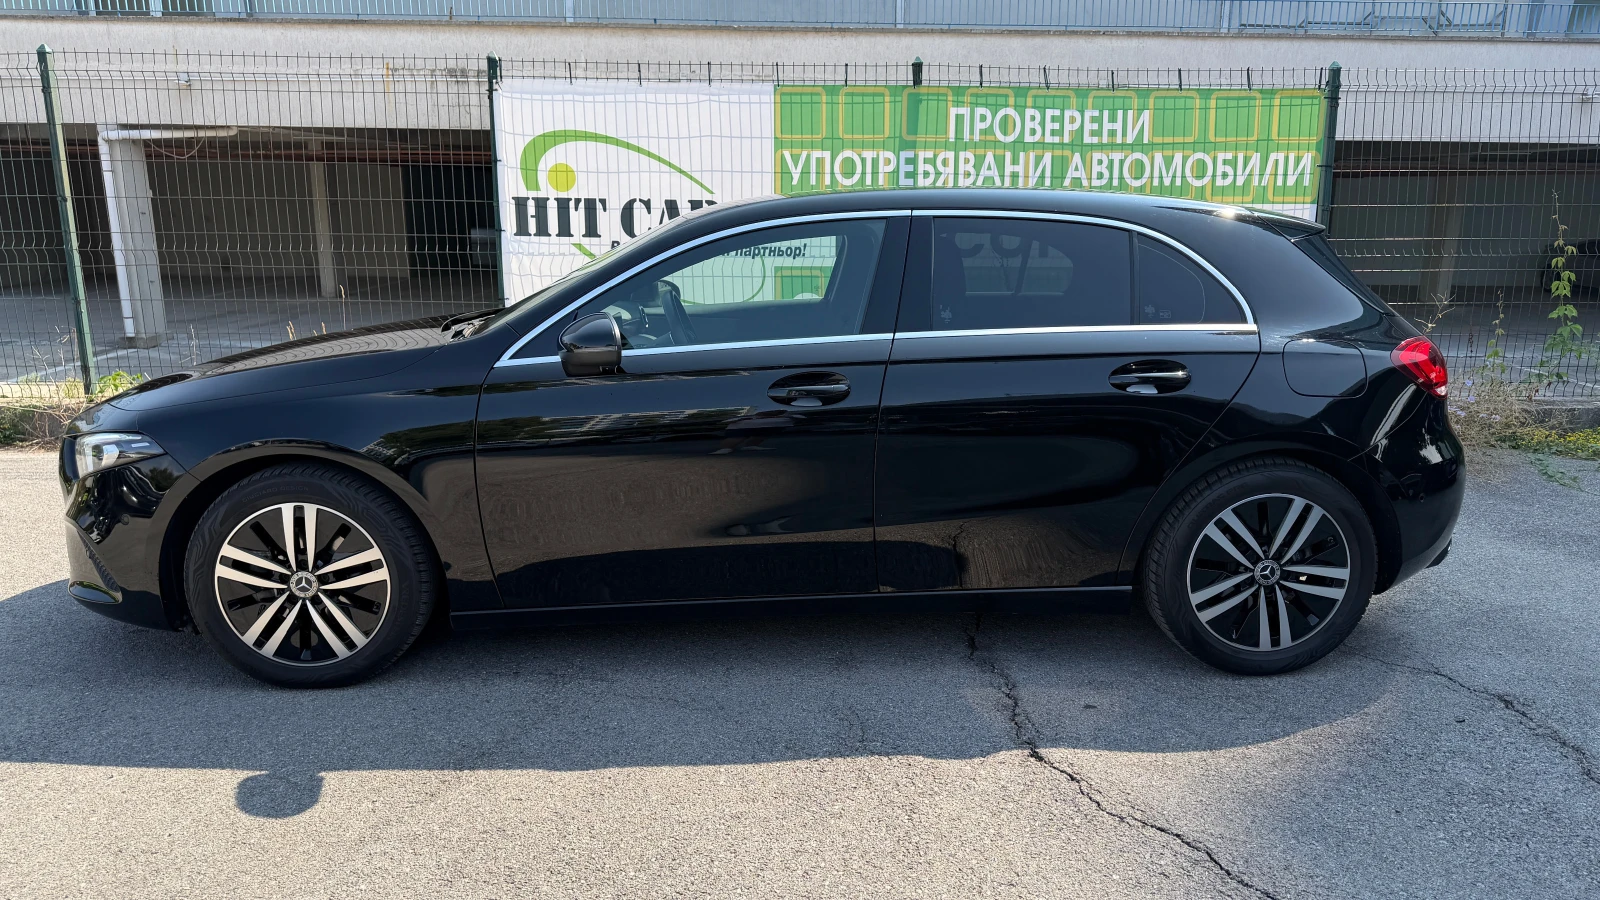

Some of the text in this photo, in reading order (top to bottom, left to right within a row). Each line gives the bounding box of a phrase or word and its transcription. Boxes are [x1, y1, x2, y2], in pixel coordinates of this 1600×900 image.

[948, 107, 1150, 144] ПРОВЕРЕНИ
[782, 149, 1312, 187] УПОТРЕБЯВАНИ АВТОМОБИЛИ
[511, 196, 607, 238] HIT
[735, 243, 807, 260] партньор!
